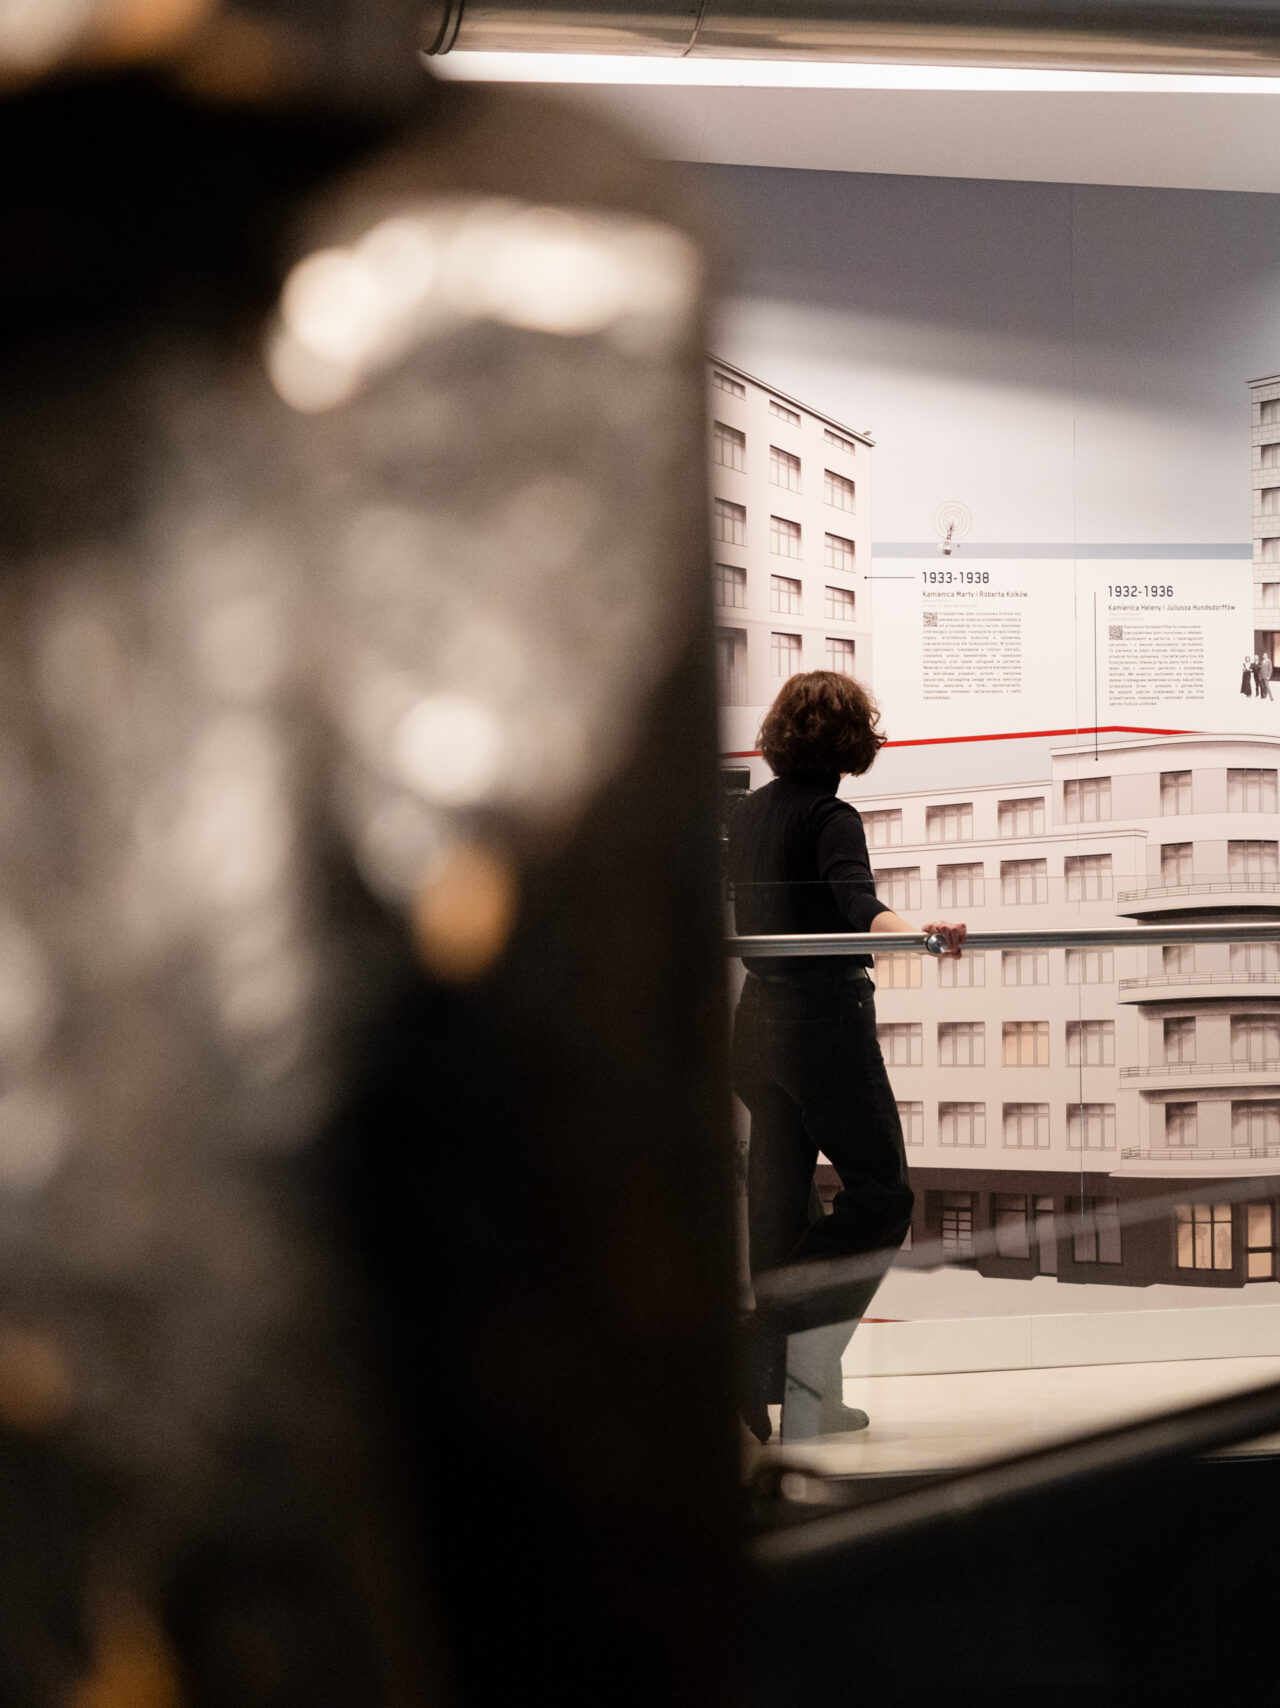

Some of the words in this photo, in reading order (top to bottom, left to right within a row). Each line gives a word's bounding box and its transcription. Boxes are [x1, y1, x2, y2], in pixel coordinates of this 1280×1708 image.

[922, 571, 990, 584] 1933-1938
[922, 590, 955, 598] Kamienica
[956, 590, 974, 599] Marty
[979, 590, 1005, 598] Roberta
[1107, 585, 1174, 598] 1932-1936
[1108, 604, 1139, 612] Kamienica
[1141, 604, 1161, 613] Heleny
[1166, 604, 1192, 612] Juliusza
